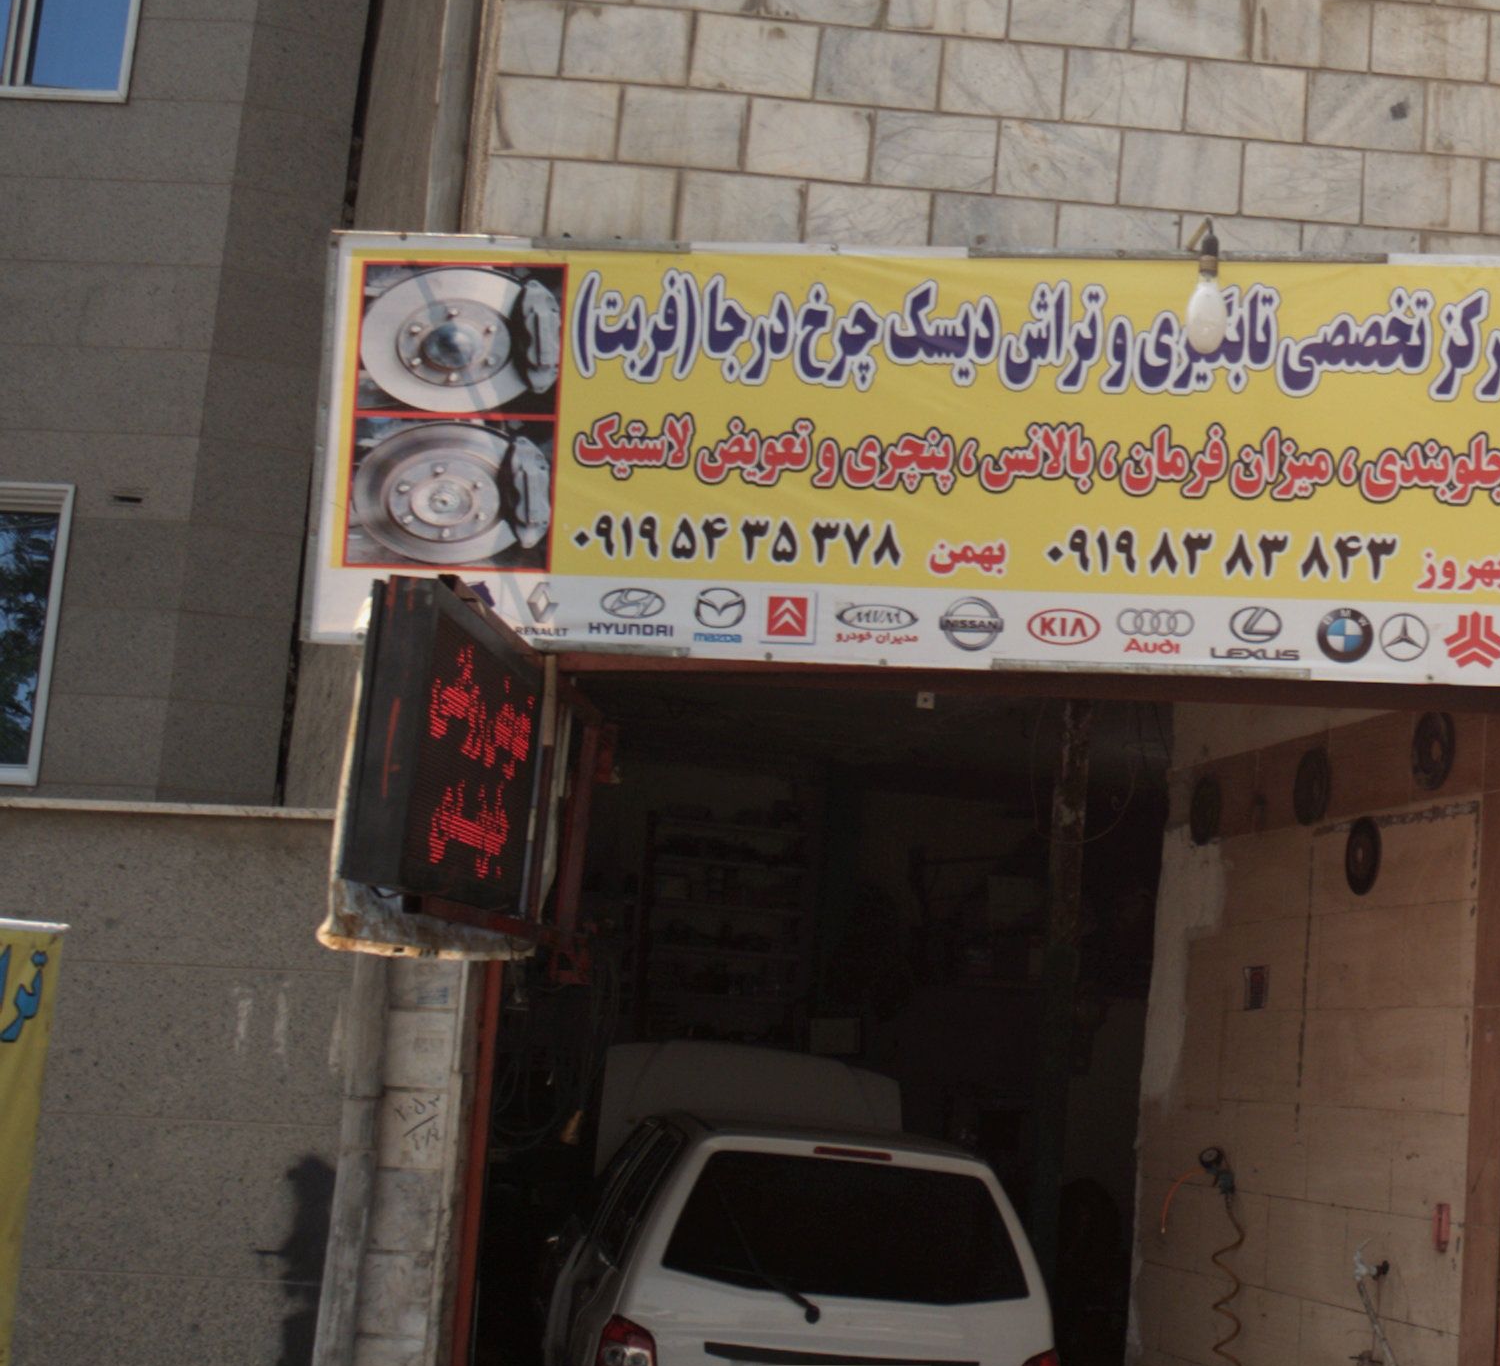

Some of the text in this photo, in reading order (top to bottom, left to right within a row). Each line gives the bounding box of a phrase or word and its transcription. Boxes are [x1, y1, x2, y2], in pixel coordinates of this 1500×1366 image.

[706, 279, 791, 382] درجا
[797, 286, 881, 387] چرخ
[887, 284, 997, 383] دیسک
[1002, 283, 1102, 389] تراش
[1103, 318, 1130, 390] و
[1279, 291, 1429, 395] تخصصی
[576, 413, 693, 478] لاستیک
[697, 419, 813, 485] تعویض
[812, 439, 839, 487] و
[845, 428, 954, 492] پنچری
[1231, 428, 1333, 500] میزان
[927, 539, 1008, 576] بهمن
[514, 626, 570, 637] RENAULT
[587, 621, 674, 637] HYUNDAI
[692, 632, 743, 644] mazda
[834, 630, 919, 645] مدیران خودرو
[944, 619, 999, 631] NISSAN
[1039, 617, 1089, 638] KIA
[1123, 638, 1182, 655] Audi
[1209, 646, 1301, 662] LEXUS
